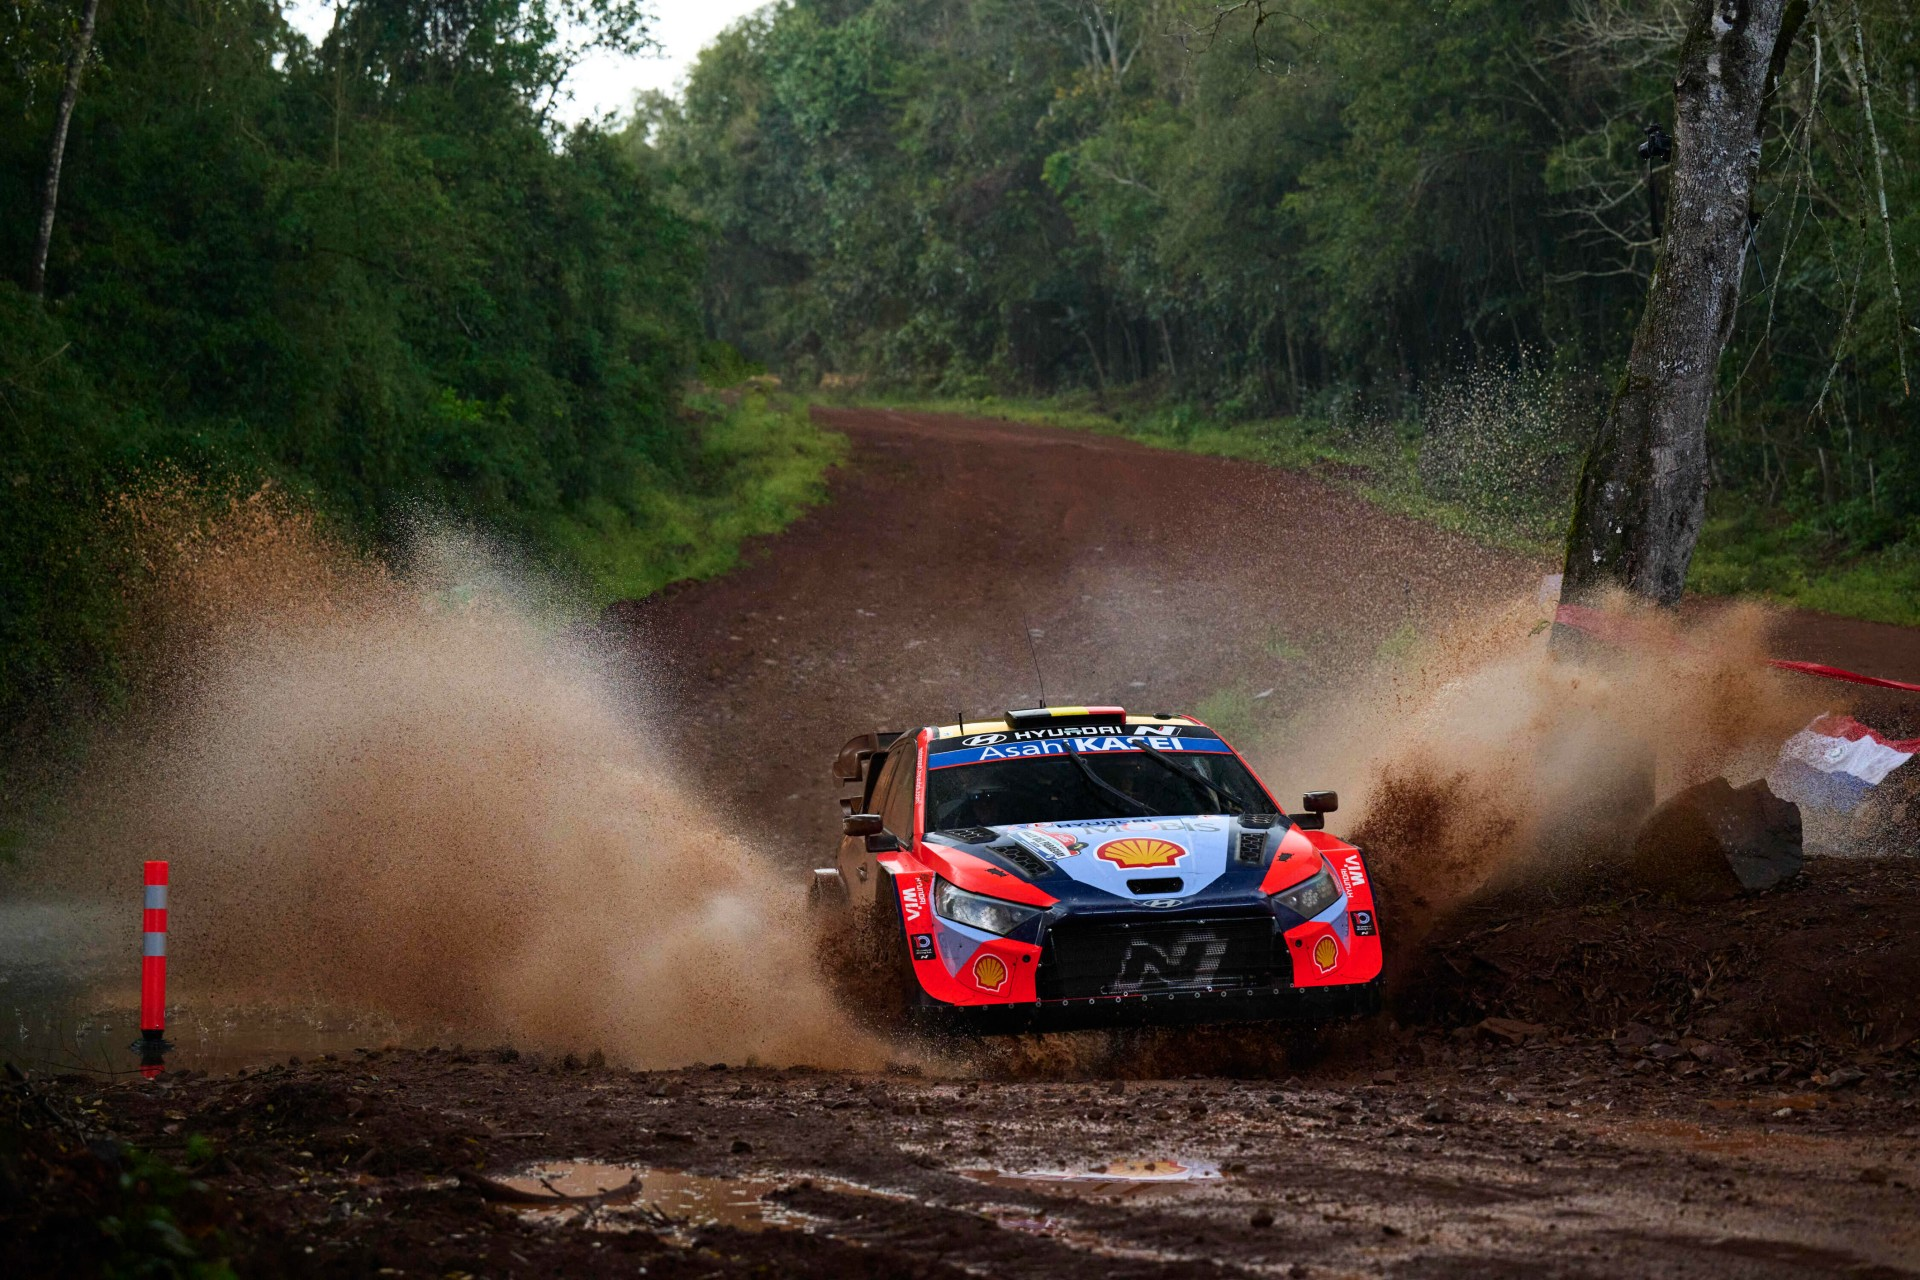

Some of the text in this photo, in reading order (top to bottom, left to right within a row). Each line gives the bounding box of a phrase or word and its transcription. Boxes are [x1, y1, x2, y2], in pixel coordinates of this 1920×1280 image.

[1074, 737, 1183, 751] KASEI
[1083, 822, 1221, 834] MOBIS
[1340, 868, 1354, 898] HYUNDAI
